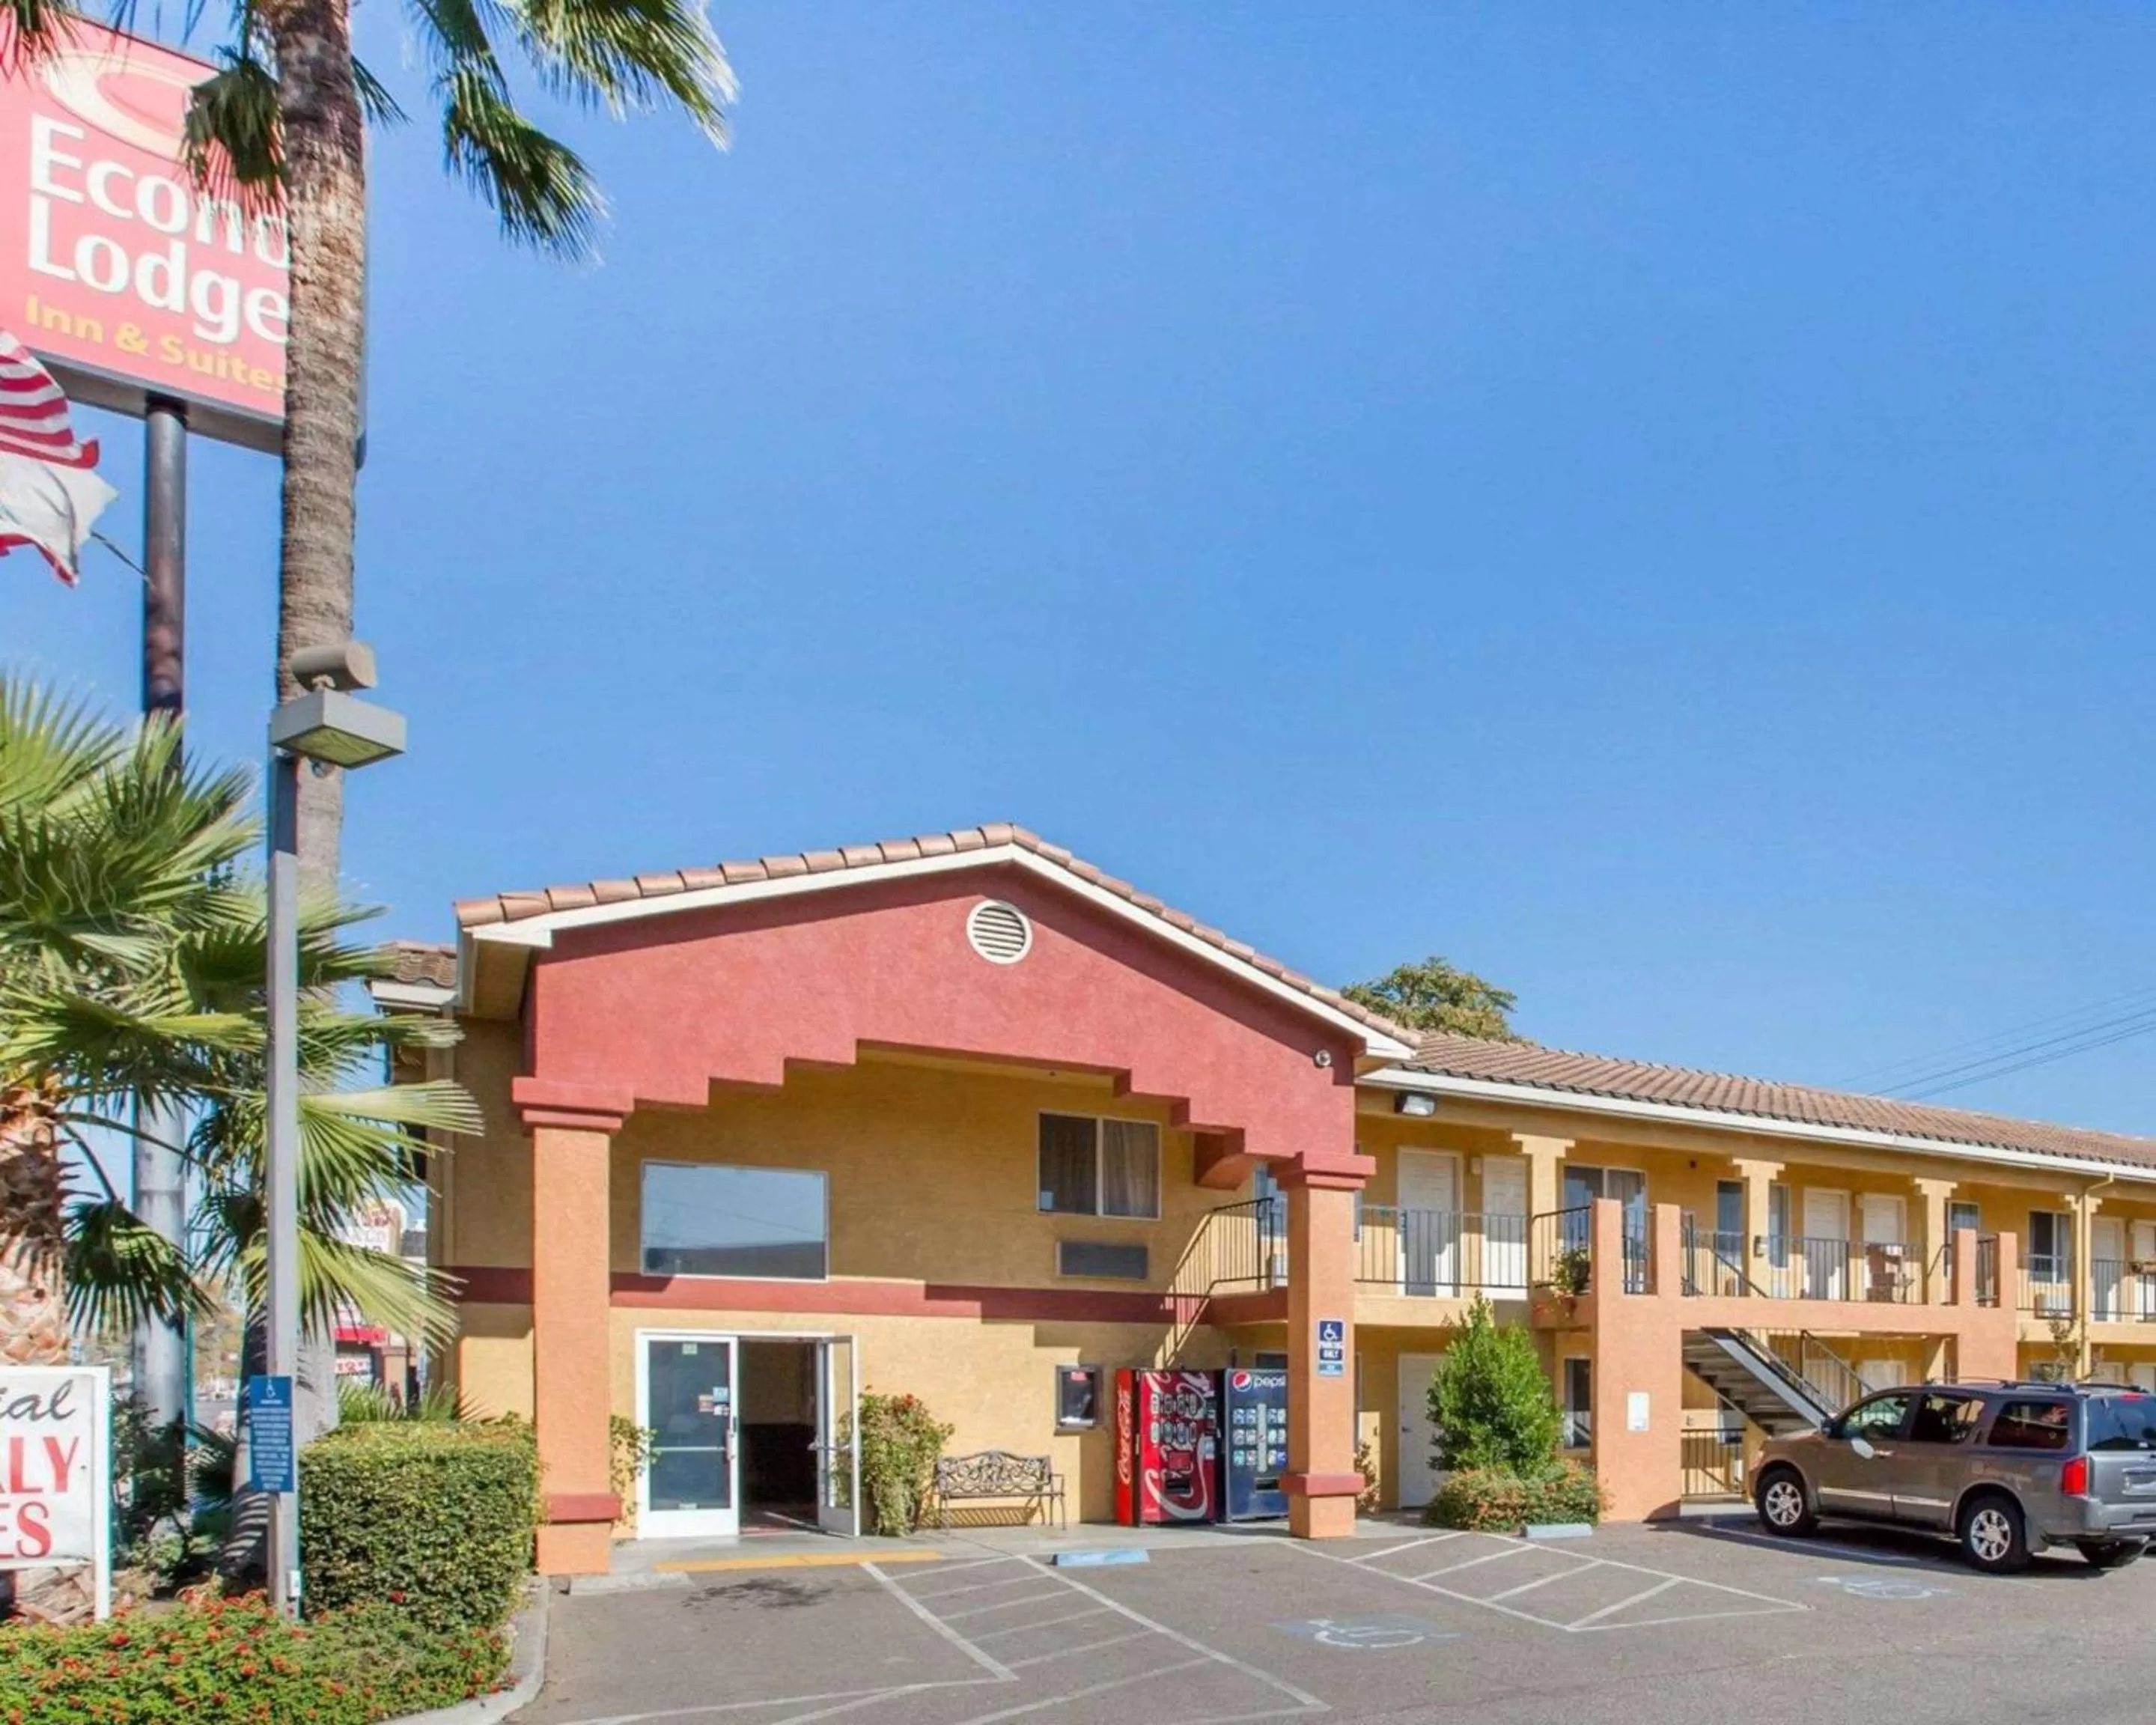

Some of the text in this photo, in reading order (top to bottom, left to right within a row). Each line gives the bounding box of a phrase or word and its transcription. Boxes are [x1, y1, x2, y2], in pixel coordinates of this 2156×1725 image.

[28, 194, 290, 344] Lodge
[26, 294, 104, 344] Inn
[115, 322, 150, 356] &
[0, 1437, 79, 1494] LY
